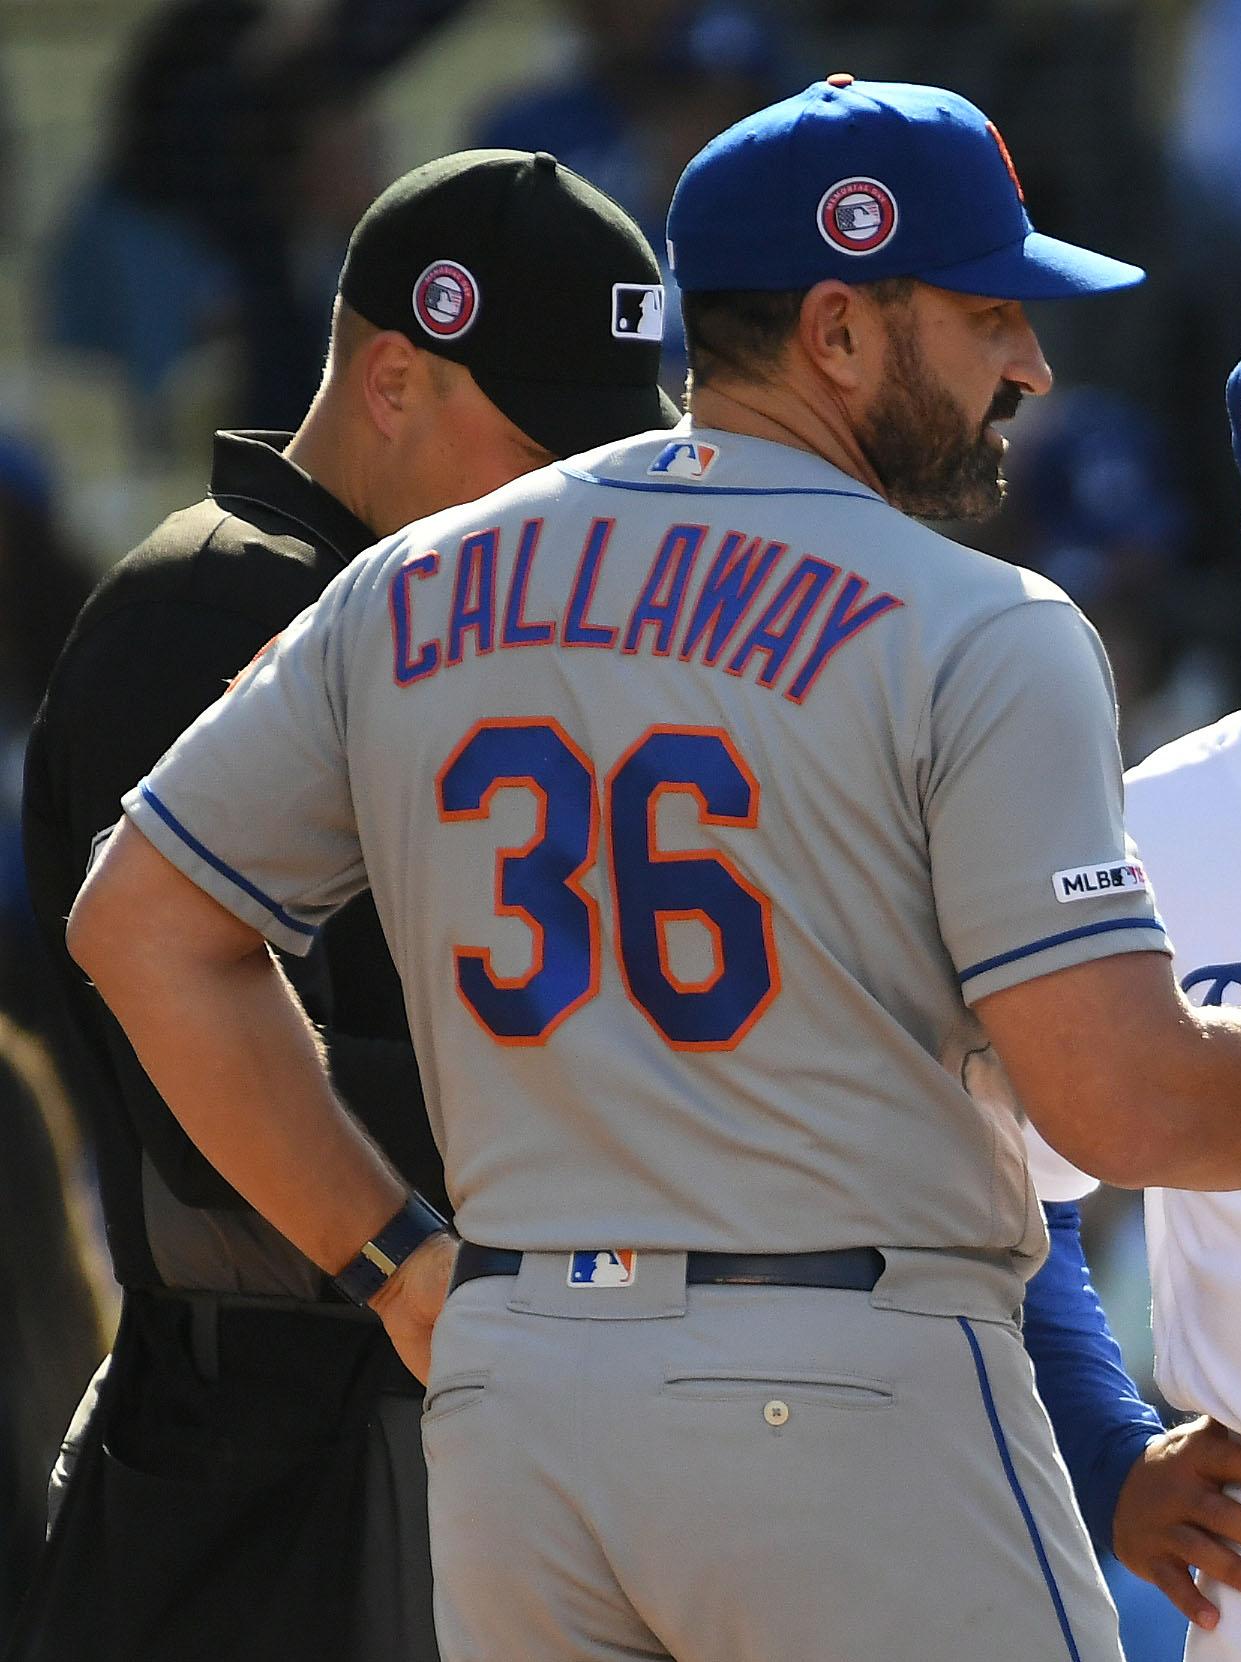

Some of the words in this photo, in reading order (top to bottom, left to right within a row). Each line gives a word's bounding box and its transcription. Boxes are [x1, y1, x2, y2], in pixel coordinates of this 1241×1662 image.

[387, 516, 904, 706] CALLAWAY
[434, 715, 781, 1052] 36
[1062, 870, 1111, 896] MLB
